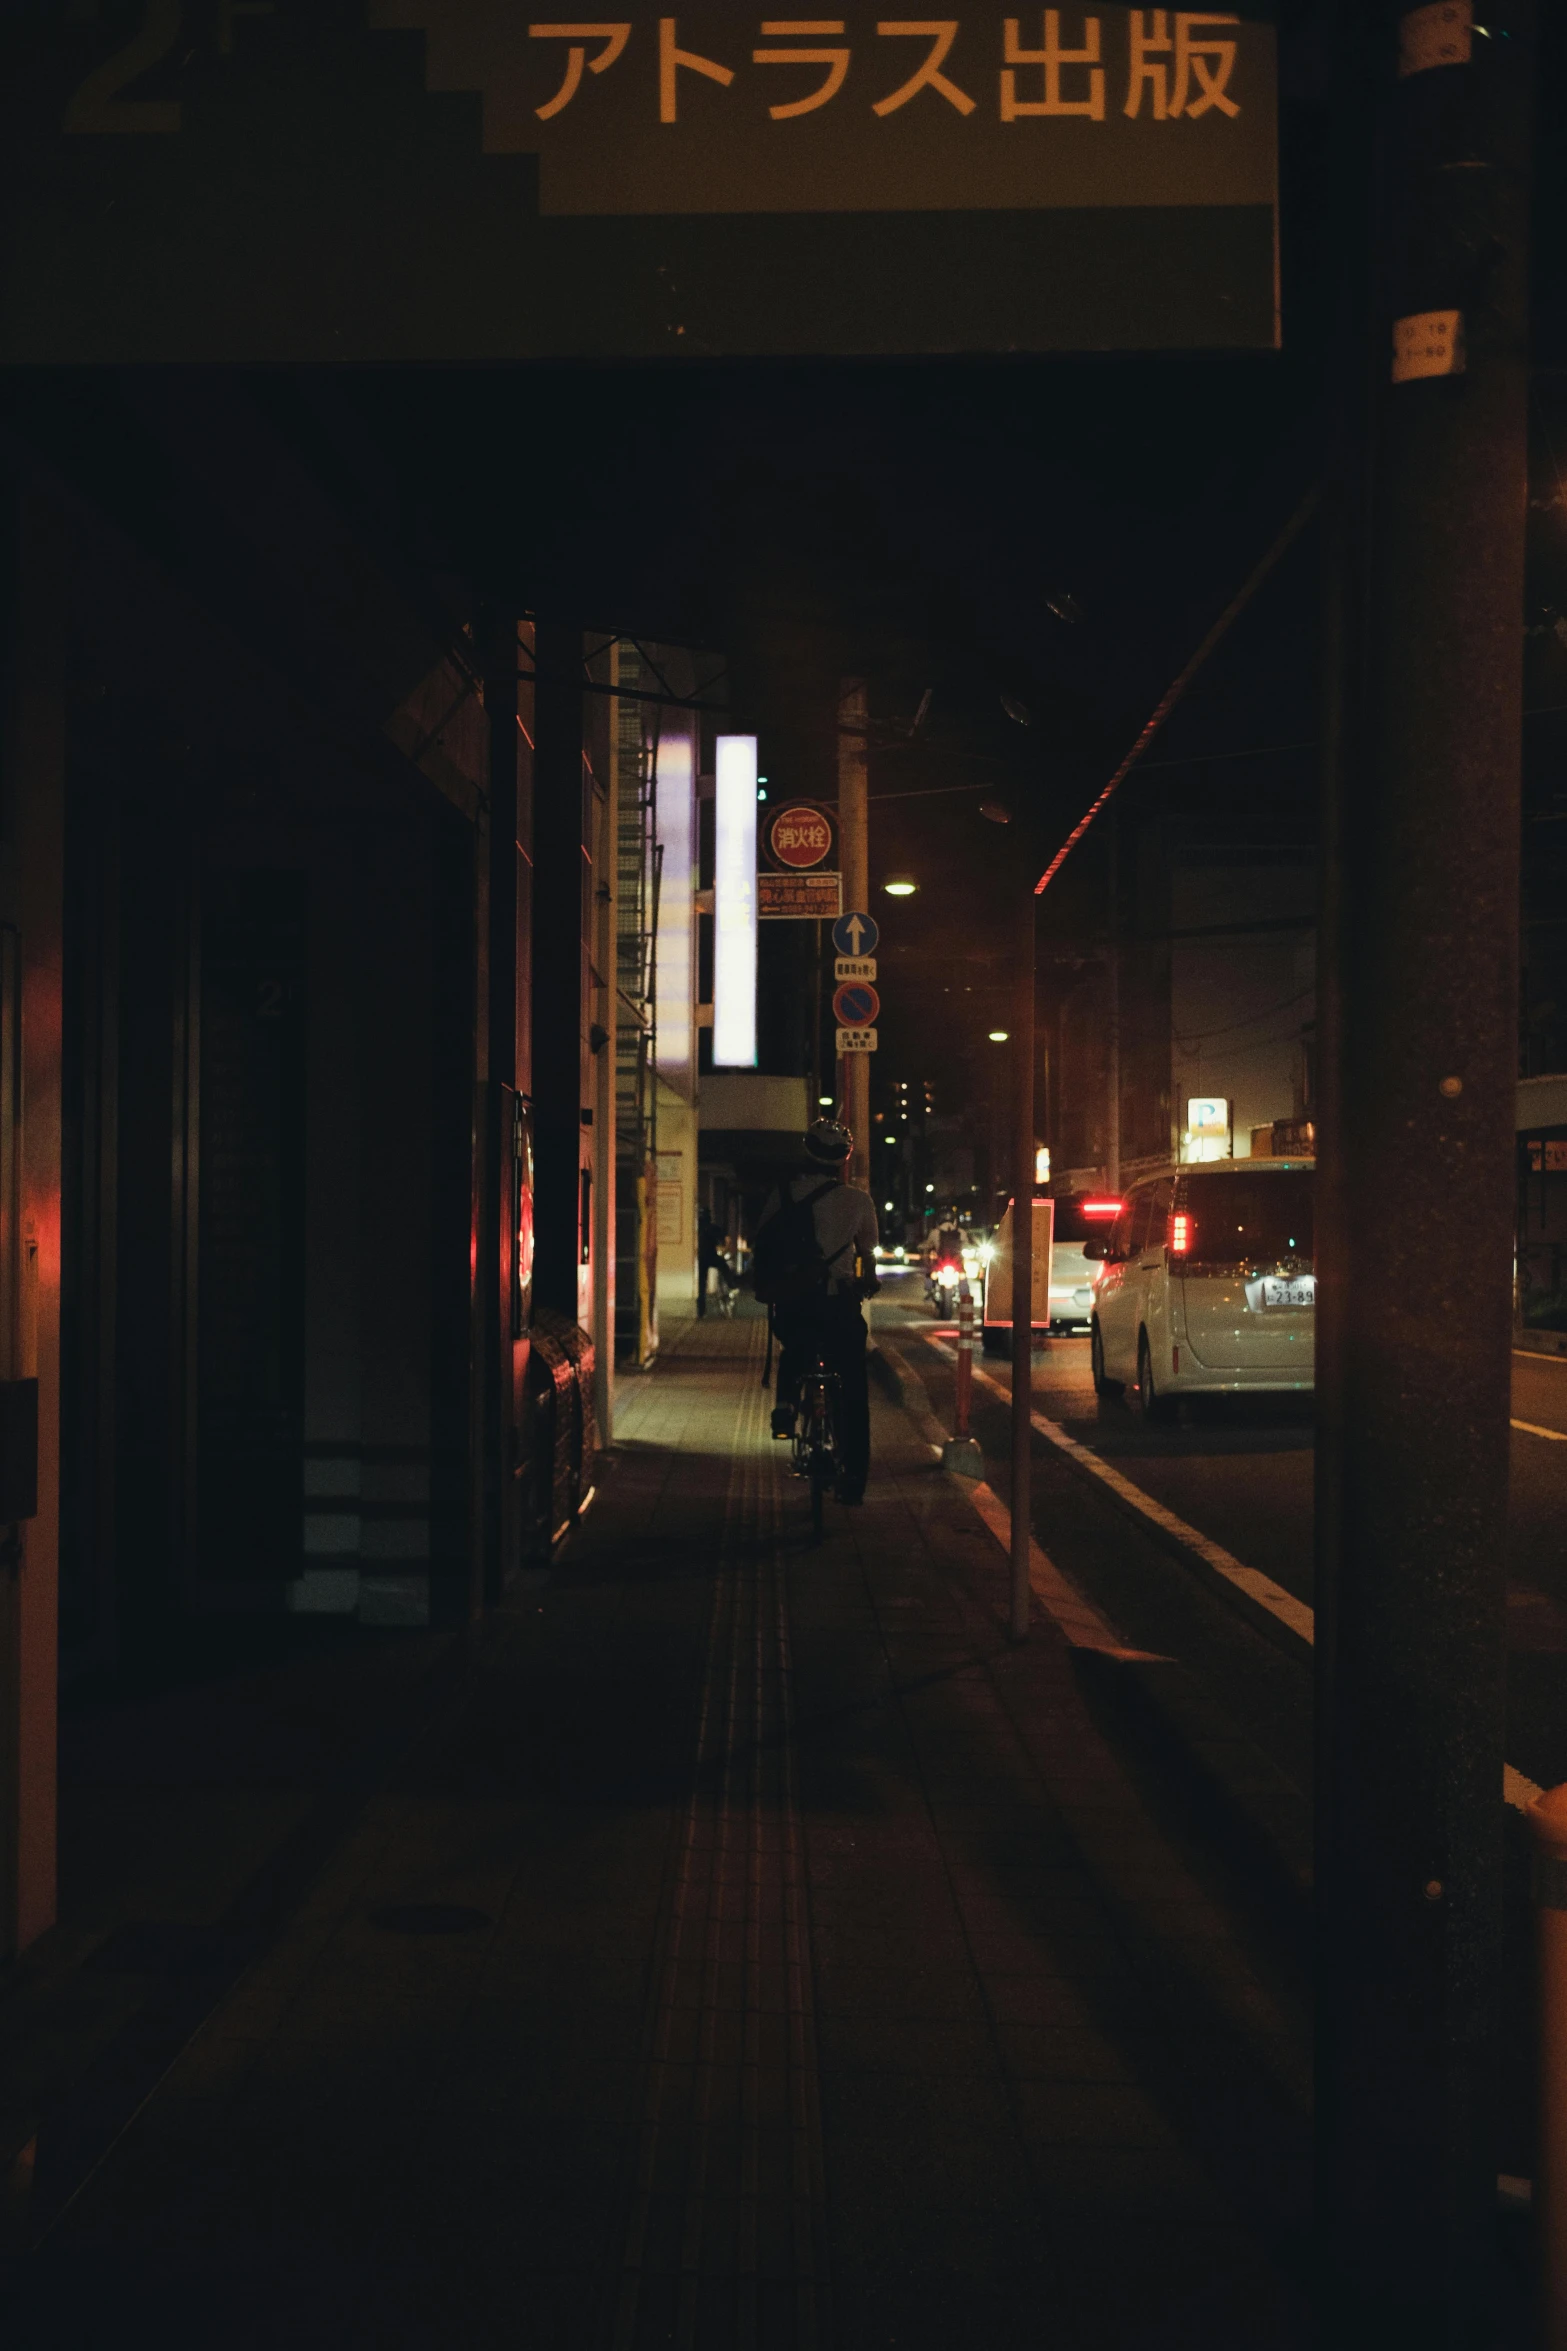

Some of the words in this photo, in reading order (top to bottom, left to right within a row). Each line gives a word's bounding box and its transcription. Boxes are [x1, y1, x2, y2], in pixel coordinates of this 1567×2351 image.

[528, 9, 1242, 122] アトラス出版
[777, 825, 826, 849] 消火栓
